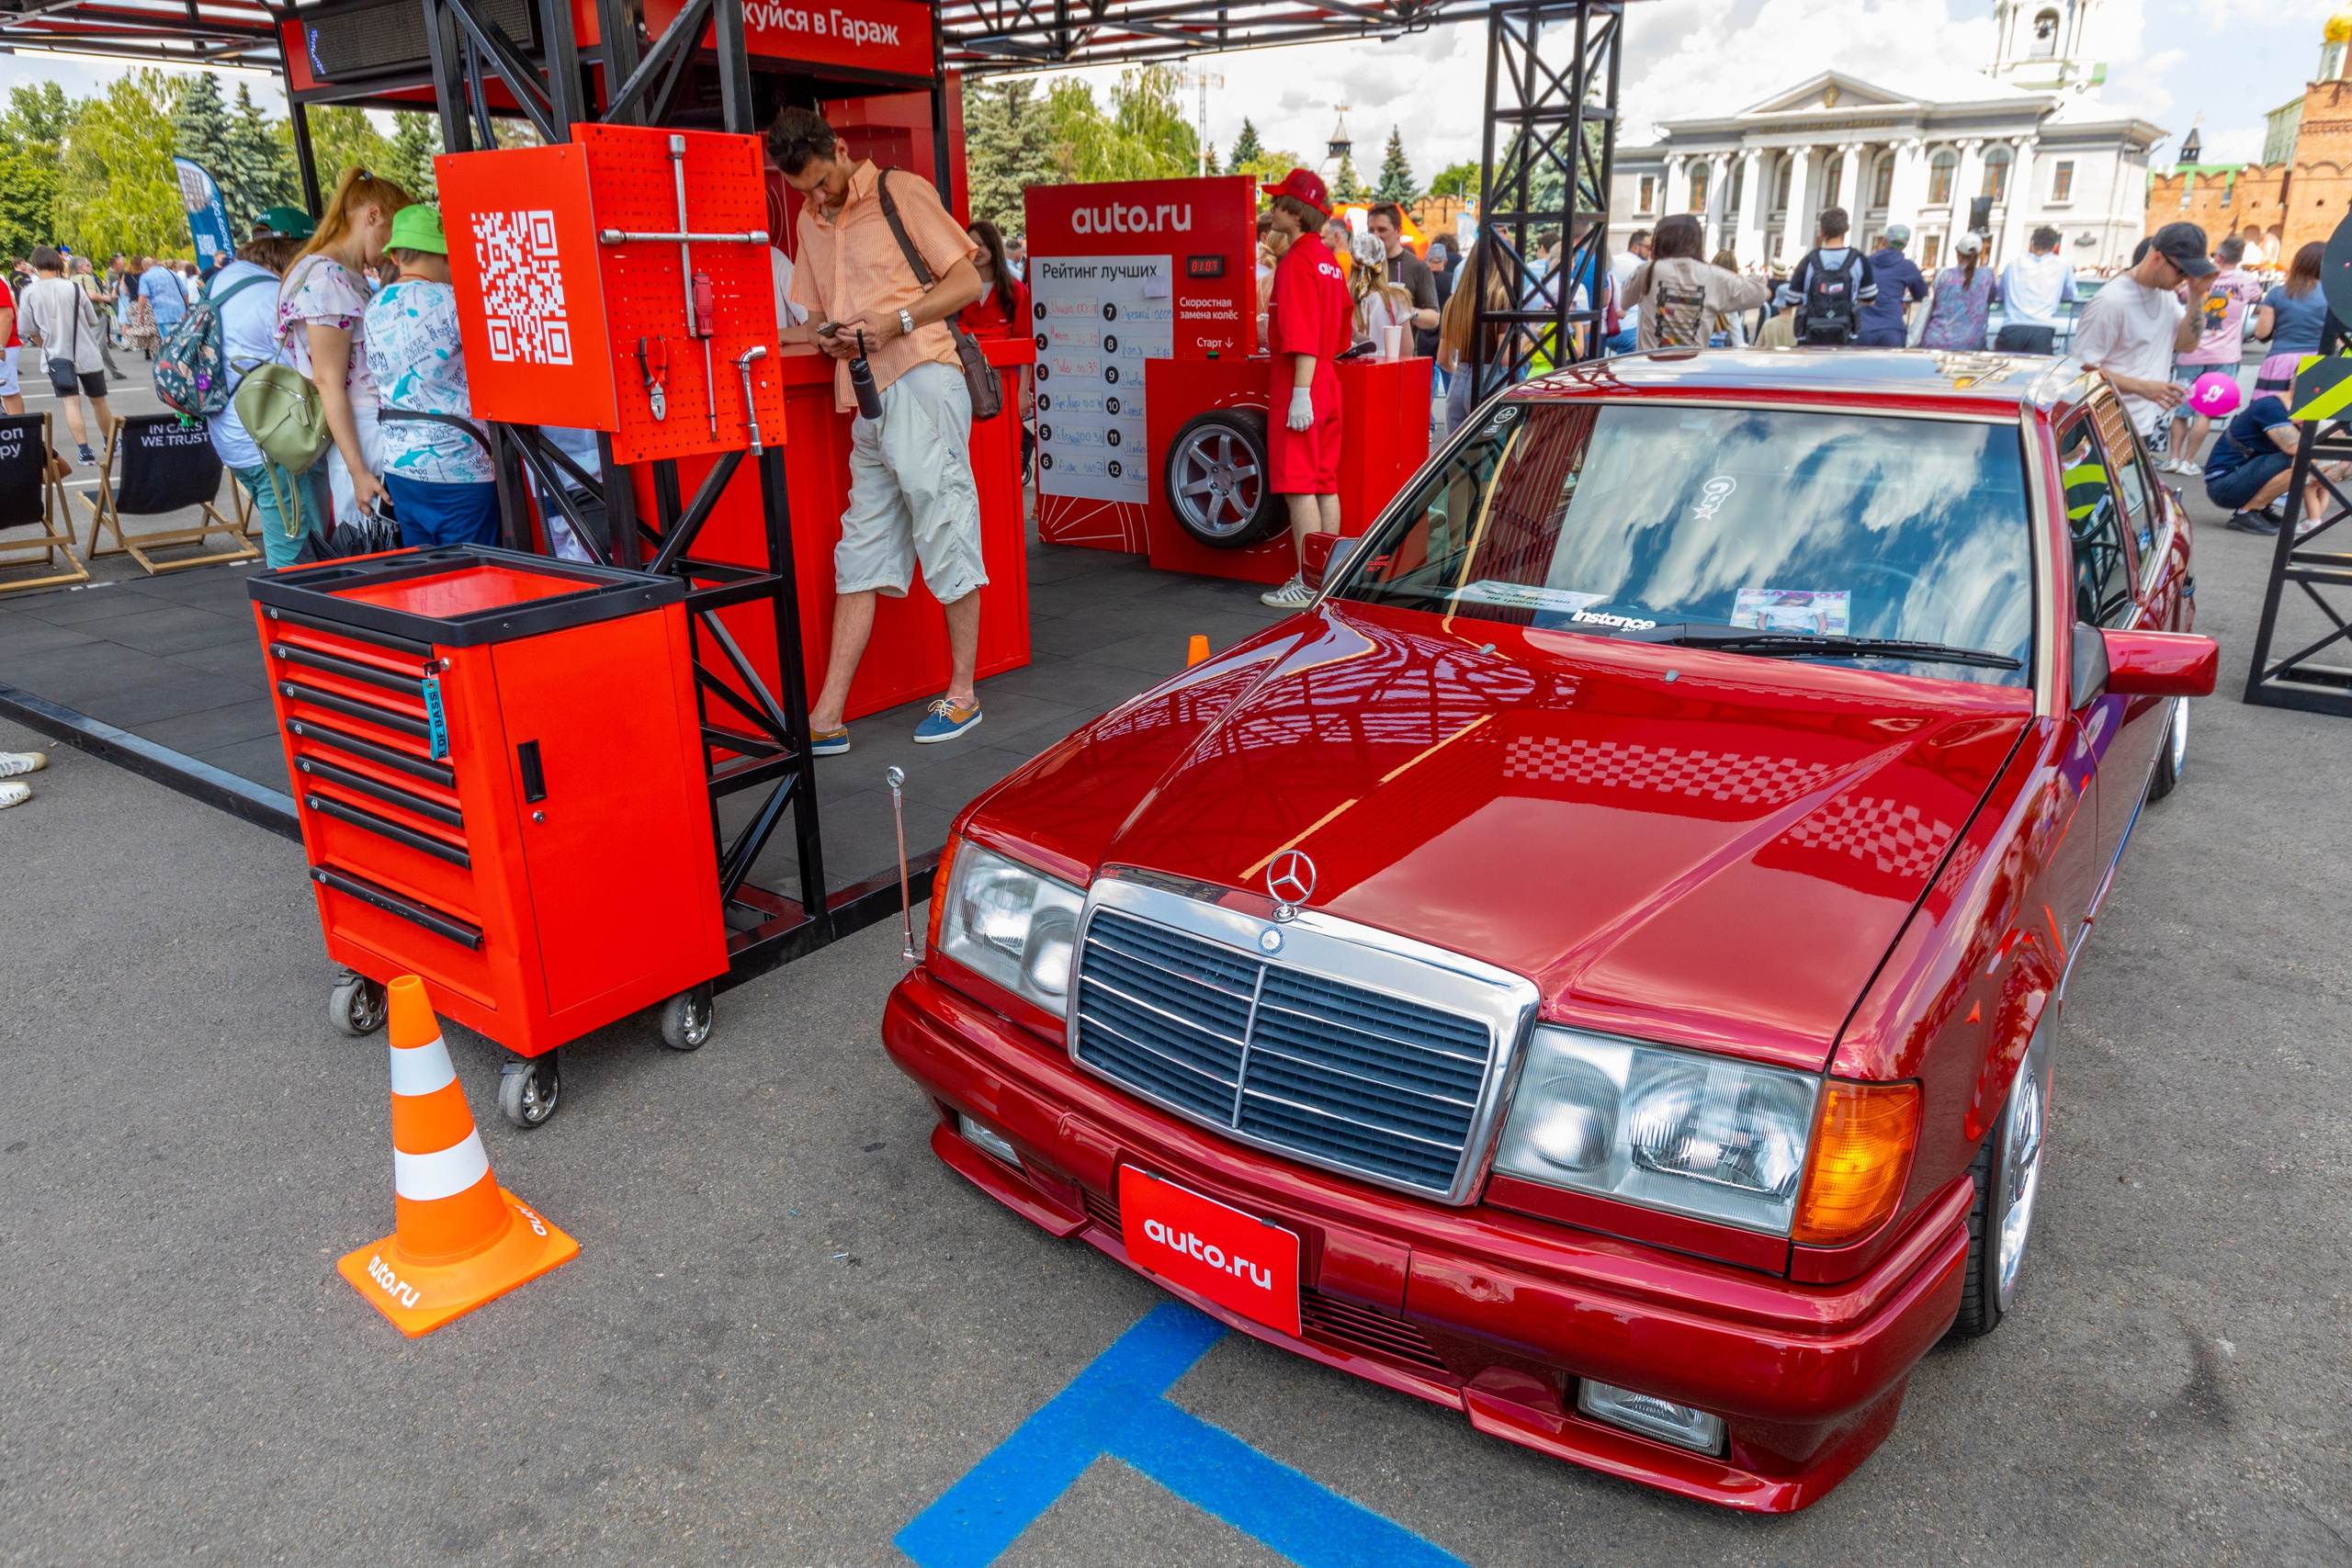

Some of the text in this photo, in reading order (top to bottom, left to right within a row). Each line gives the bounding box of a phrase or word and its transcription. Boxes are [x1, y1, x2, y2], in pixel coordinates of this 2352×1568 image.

[813, 12, 827, 35] в
[830, 8, 899, 46] Гараж
[1071, 201, 1192, 234] auto.ru
[1042, 262, 1158, 282] Рейтинг лучших
[1179, 296, 1232, 310] Скоростная
[1036, 306, 1042, 317] 1
[1106, 307, 1114, 319] 7
[1180, 310, 1238, 321] замена колёс
[1038, 337, 1045, 348] 2
[1107, 338, 1114, 350] 8
[1196, 336, 1222, 350] Старт
[1039, 368, 1046, 378] 3
[1108, 370, 1115, 382] 9
[1040, 398, 1046, 409] 4
[1108, 400, 1118, 412] 10
[149, 423, 164, 434] IN
[1042, 427, 1048, 438] 5
[141, 432, 210, 447] WE TRUST
[1109, 432, 1117, 444] 11
[1043, 457, 1049, 468] 6
[1109, 464, 1120, 476] 12
[1741, 589, 1847, 599] PLAYBOY
[1570, 608, 1657, 631] Instance
[429, 691, 443, 728] BASS
[1144, 1219, 1272, 1291] auto.ru
[368, 1255, 421, 1309] auto.ru
